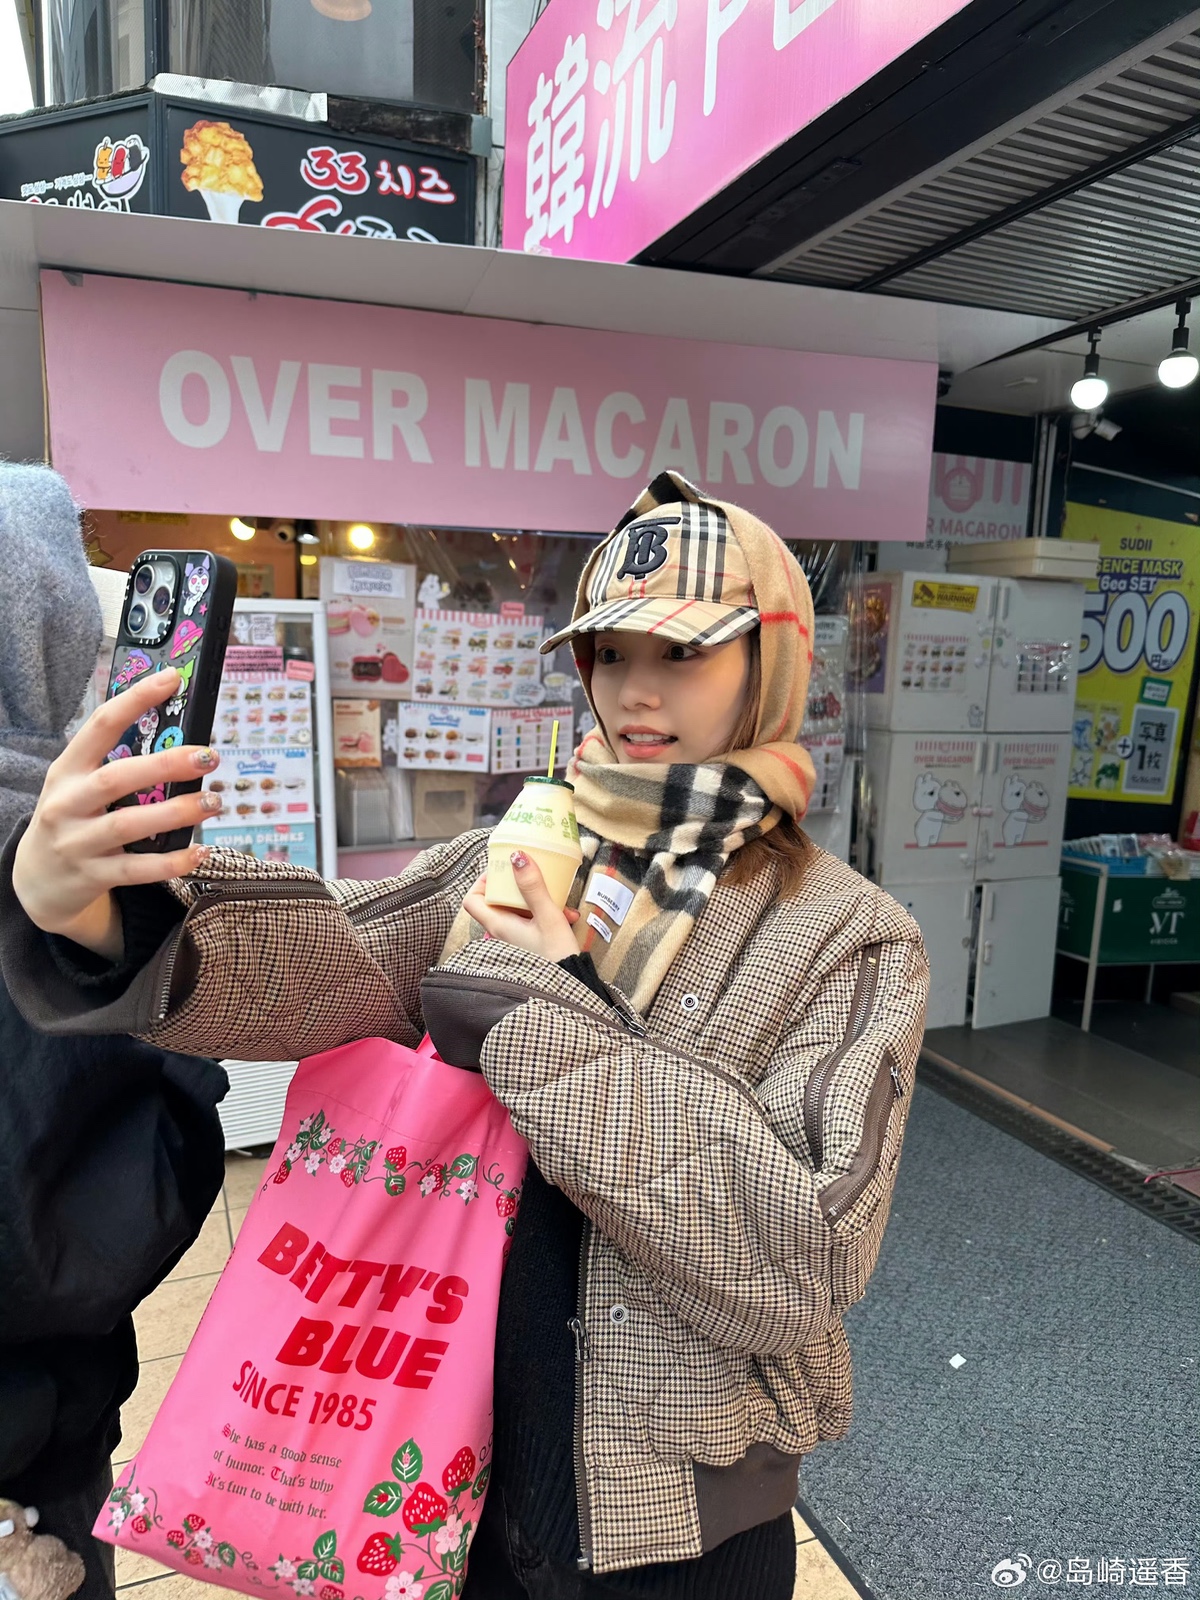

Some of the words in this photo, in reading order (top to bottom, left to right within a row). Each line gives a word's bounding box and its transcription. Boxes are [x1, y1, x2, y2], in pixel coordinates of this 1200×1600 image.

[300, 146, 370, 195] 33
[375, 160, 457, 204] 치즈
[159, 350, 434, 464] OVER
[465, 378, 864, 490] MACARON
[940, 518, 1023, 542] MACARON
[1119, 537, 1153, 552] SUDII
[1100, 575, 1128, 591] 6ea
[1128, 576, 1157, 592] SET
[1141, 560, 1182, 576] MASK
[1078, 590, 1190, 674] 500
[1138, 721, 1168, 744] 写真
[215, 834, 253, 846] KUMA
[256, 831, 305, 844] DRINKS
[257, 1222, 469, 1324] BETTY'S
[275, 1316, 450, 1390] BLUE
[232, 1360, 304, 1418] SINCE
[308, 1391, 377, 1431] 1985
[222, 1423, 241, 1444] She
[244, 1435, 267, 1451] has
[269, 1444, 277, 1454] a
[280, 1447, 307, 1463] good
[309, 1452, 342, 1468] sense
[213, 1450, 225, 1463] of
[225, 1455, 265, 1476] humor.
[270, 1466, 306, 1488] That's
[309, 1477, 334, 1494] why
[205, 1471, 225, 1491] It's
[227, 1480, 247, 1496] fun
[250, 1487, 262, 1501] to
[265, 1492, 277, 1507] be
[278, 1499, 304, 1515] with
[307, 1503, 327, 1519] her.
